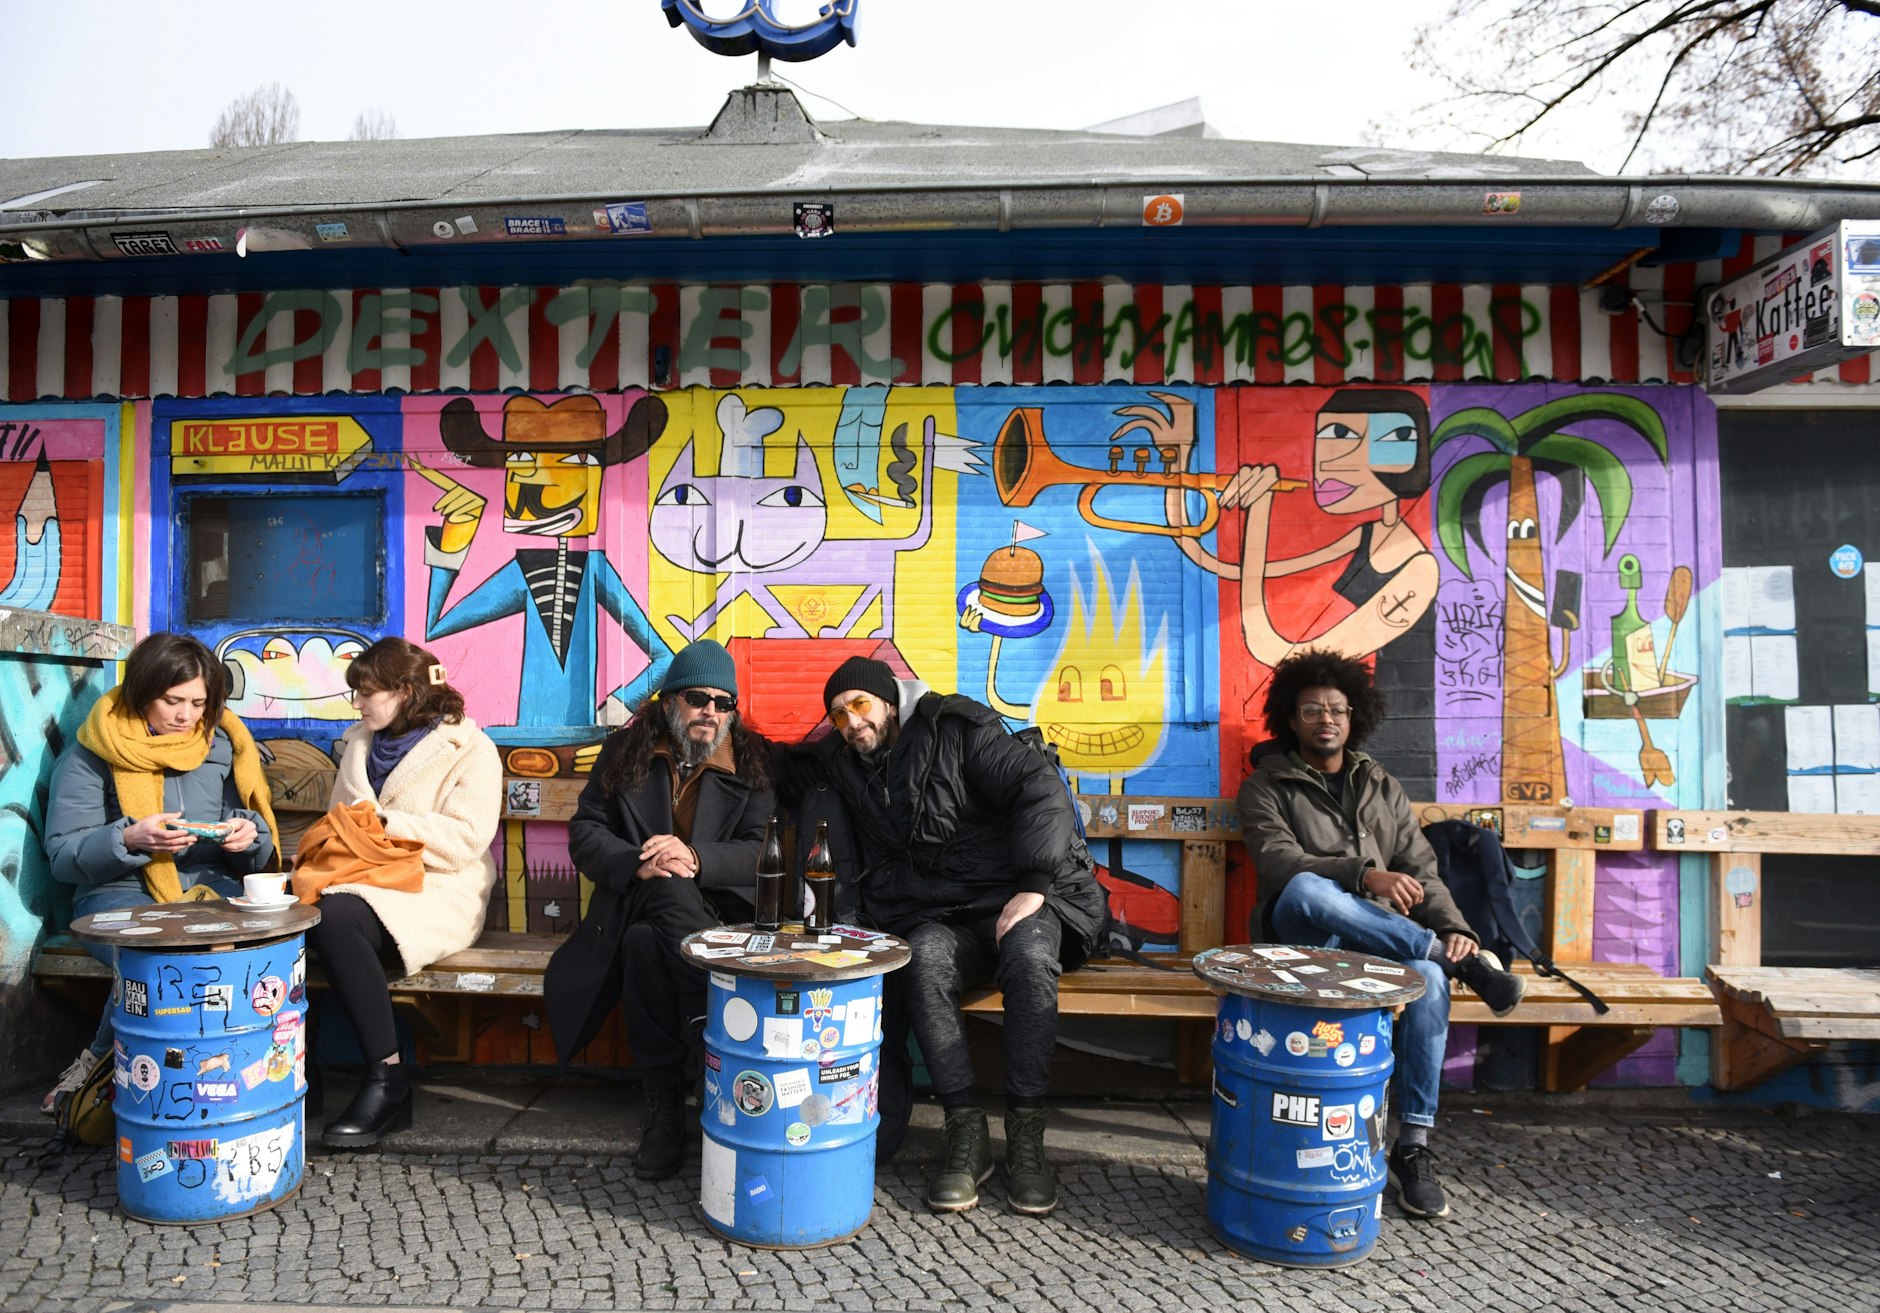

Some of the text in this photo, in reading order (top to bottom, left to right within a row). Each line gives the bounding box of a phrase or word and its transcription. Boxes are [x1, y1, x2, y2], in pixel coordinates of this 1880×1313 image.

[508, 219, 541, 227] BRACE
[510, 226, 542, 234] BRACE
[1755, 277, 1832, 338] Kaffee
[222, 283, 907, 378] DEXTER
[1507, 783, 1550, 800] GVP
[125, 979, 146, 995] BAU
[125, 990, 147, 1007] MAL
[125, 1002, 148, 1017] EIN.
[154, 1006, 192, 1016] SUPERSAD
[1311, 1020, 1343, 1035] HOT
[820, 1066, 847, 1076] UNLEASH
[820, 1073, 839, 1081] INNER
[780, 1083, 806, 1093] FASHION
[1273, 1093, 1320, 1123] PHE
[750, 1184, 767, 1197] RADIO
